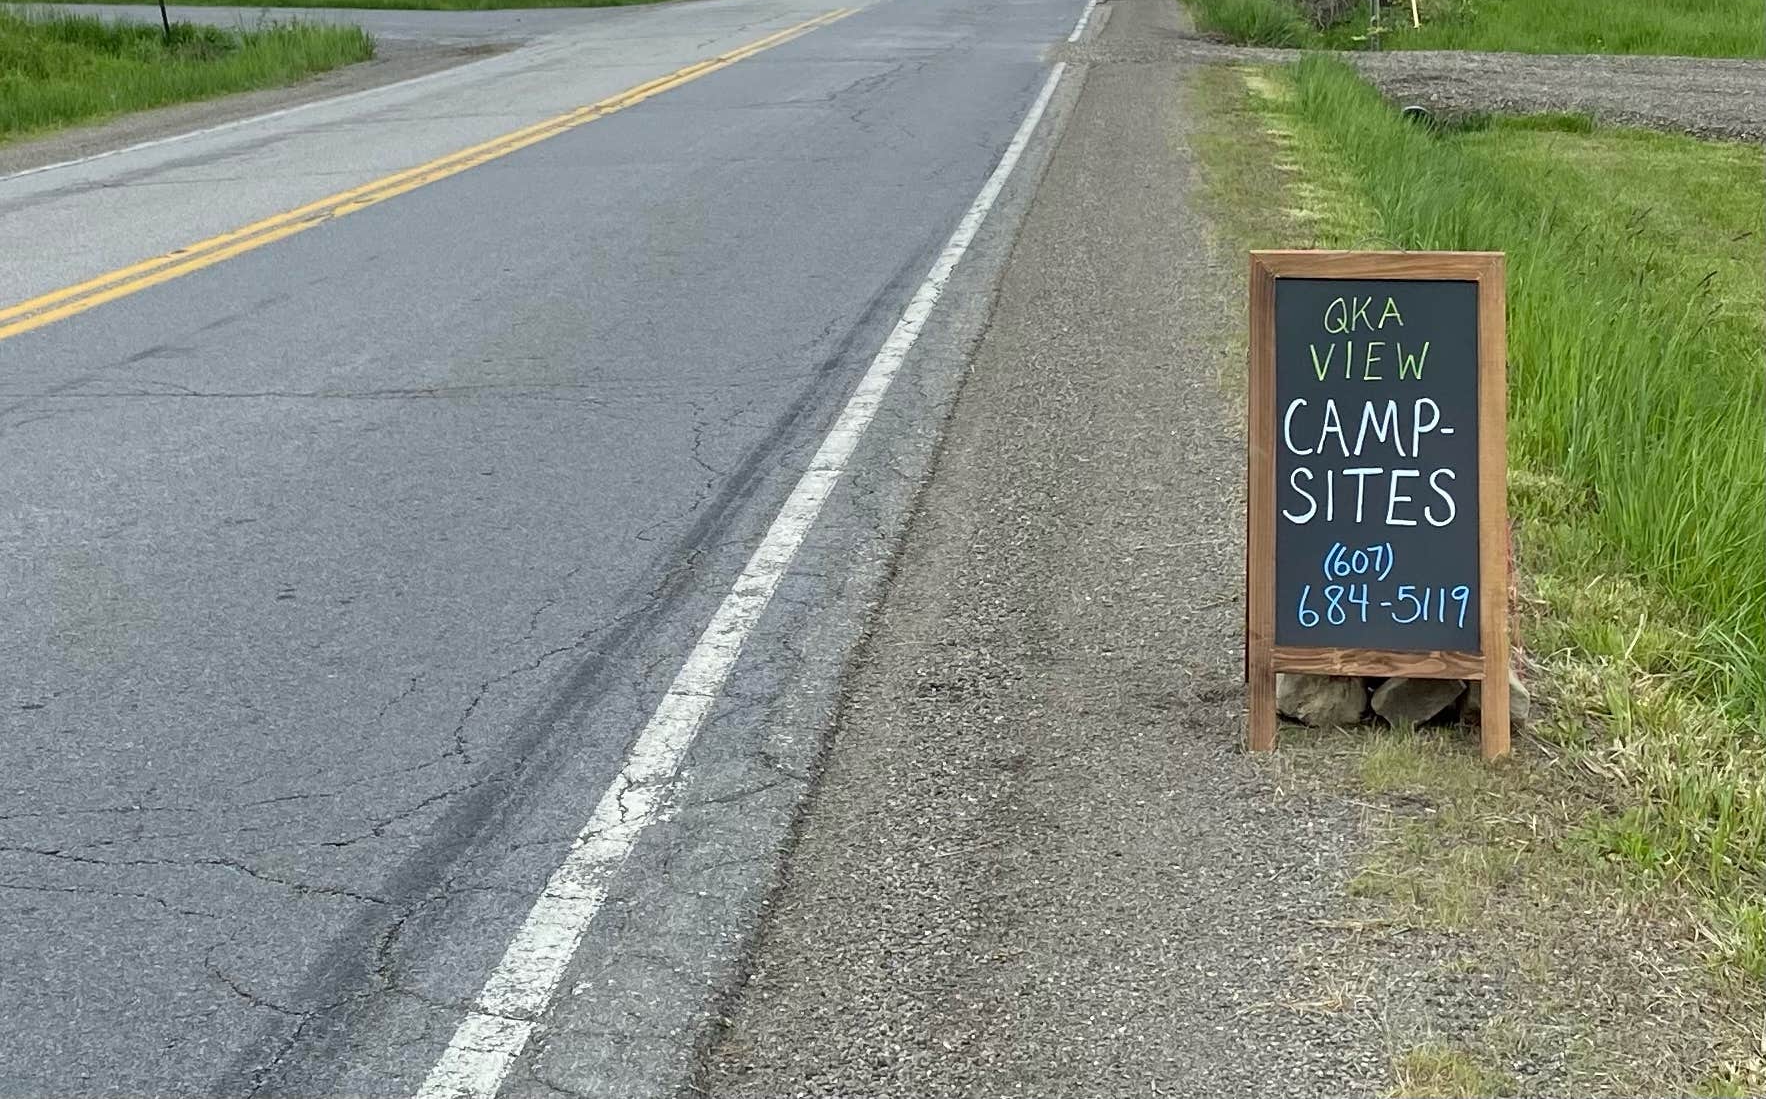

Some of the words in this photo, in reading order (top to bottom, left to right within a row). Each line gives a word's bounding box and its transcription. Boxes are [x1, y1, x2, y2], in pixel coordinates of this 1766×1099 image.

[1324, 296, 1404, 334] QKA
[1309, 340, 1430, 381] VIEW
[1283, 397, 1455, 458] CAMP-
[1282, 467, 1457, 527] SITES
[1324, 542, 1394, 581] (607)
[1298, 583, 1470, 629] 684-5119
